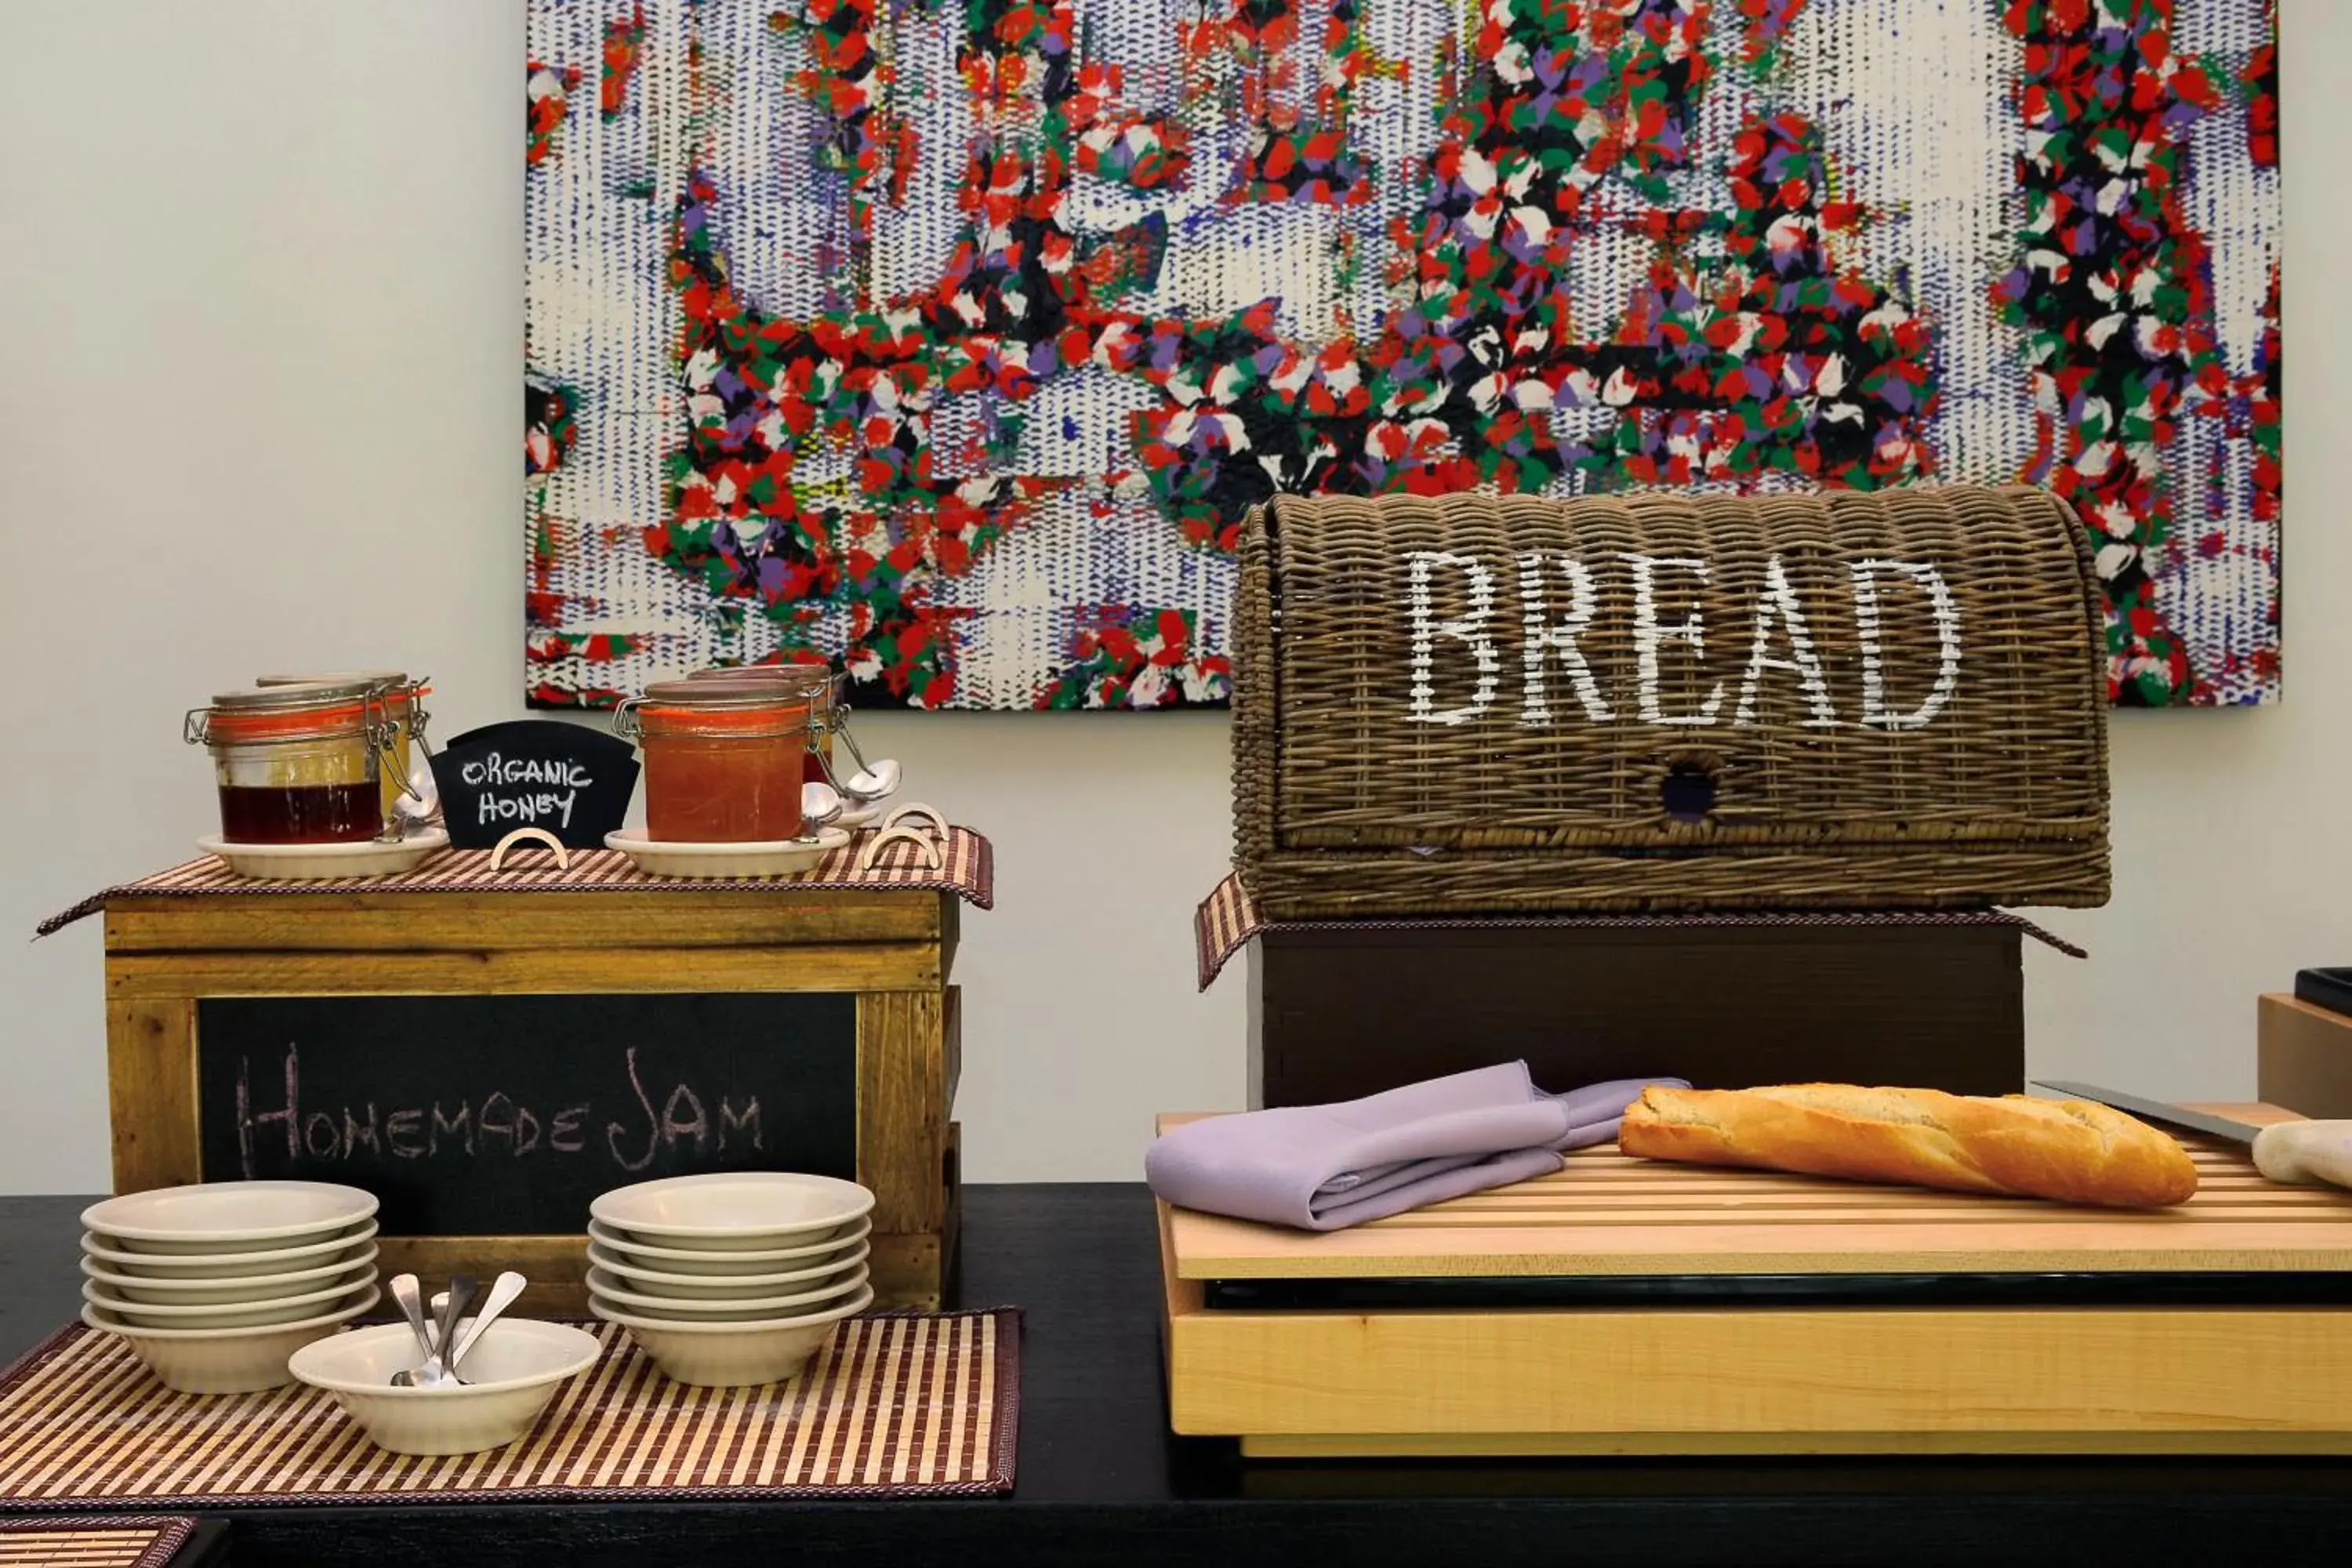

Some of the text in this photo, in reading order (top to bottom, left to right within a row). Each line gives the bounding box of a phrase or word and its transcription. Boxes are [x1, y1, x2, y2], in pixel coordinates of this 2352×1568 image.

[1402, 551, 1962, 730] BREAD
[462, 753, 593, 787] ORGANIC
[477, 789, 576, 828] HONEY
[236, 1042, 764, 1179] HOMEMADE JAM
